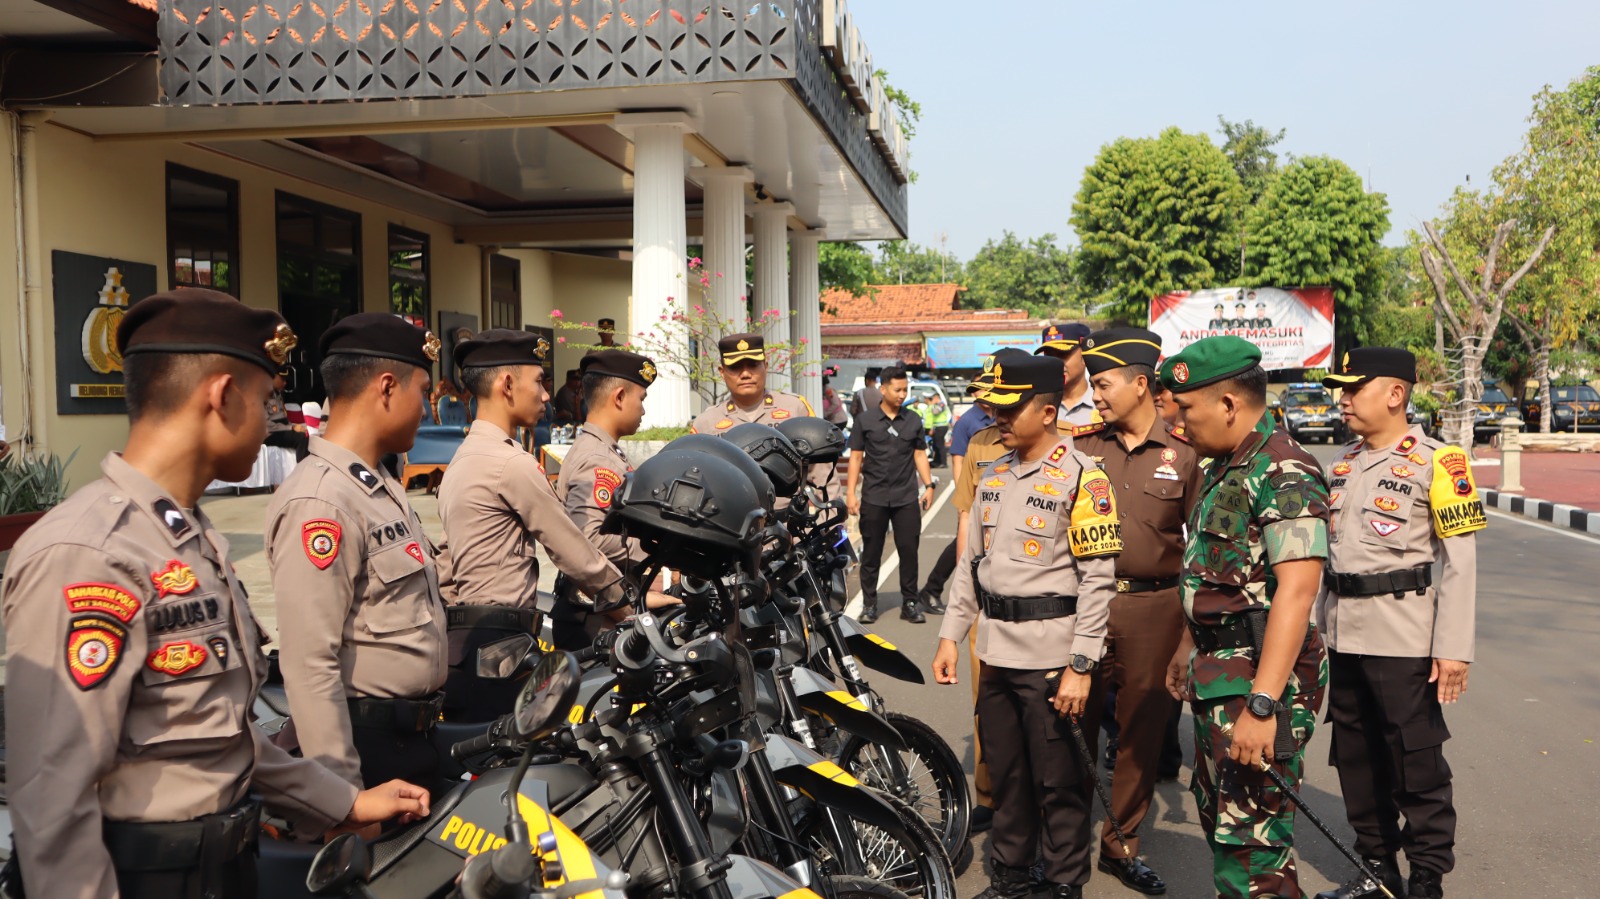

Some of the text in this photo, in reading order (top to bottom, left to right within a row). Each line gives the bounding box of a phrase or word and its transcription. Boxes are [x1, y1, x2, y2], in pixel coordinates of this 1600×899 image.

[1180, 326, 1303, 341] ANDA MEMASUKI
[1253, 339, 1305, 348] NTEGRITAS
[1378, 479, 1413, 496] POLRI
[982, 491, 994, 502] EKO
[1026, 496, 1057, 512] POLRI
[1443, 520, 1466, 531] OMPC
[1079, 543, 1098, 554] OMPC
